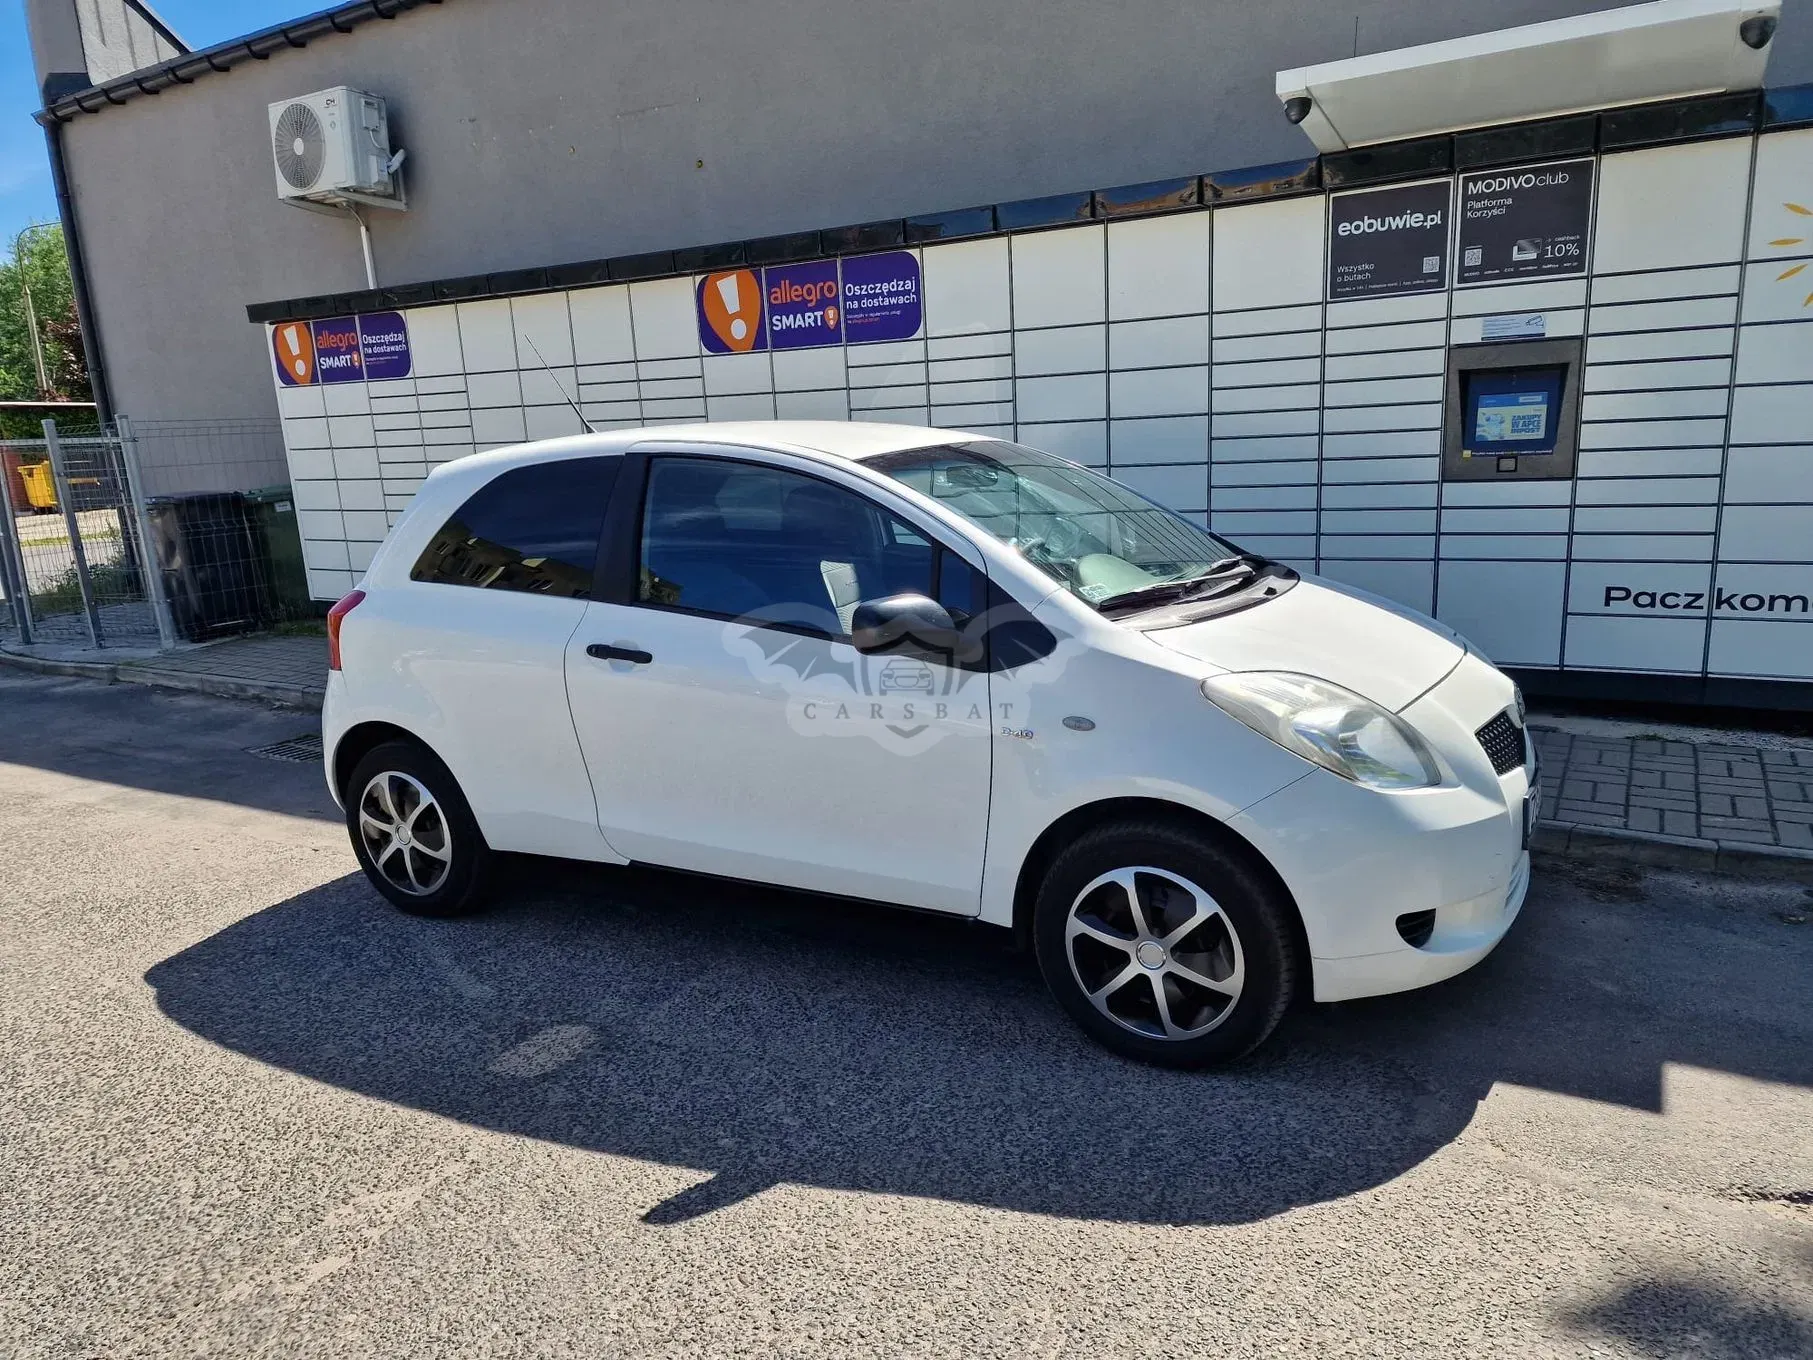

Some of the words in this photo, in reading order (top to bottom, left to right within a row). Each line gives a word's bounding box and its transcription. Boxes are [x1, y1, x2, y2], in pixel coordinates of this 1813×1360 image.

[1467, 197, 1512, 210] Platforma
[1467, 206, 1506, 219] Korzyści
[1338, 210, 1441, 236] eobuwie.pl
[1544, 243, 1580, 258] 10%
[1337, 262, 1375, 273] Wszystko
[1344, 272, 1371, 282] butach
[770, 279, 837, 307] allegro
[845, 276, 916, 296] Oszczędzaj
[846, 299, 859, 310] na
[860, 292, 917, 309] dostawach
[317, 330, 357, 351] allegro
[362, 331, 405, 345] Oszczędzaj
[364, 346, 372, 354] na
[373, 343, 407, 354] dostawach
[1604, 586, 1813, 613] Paczkom
